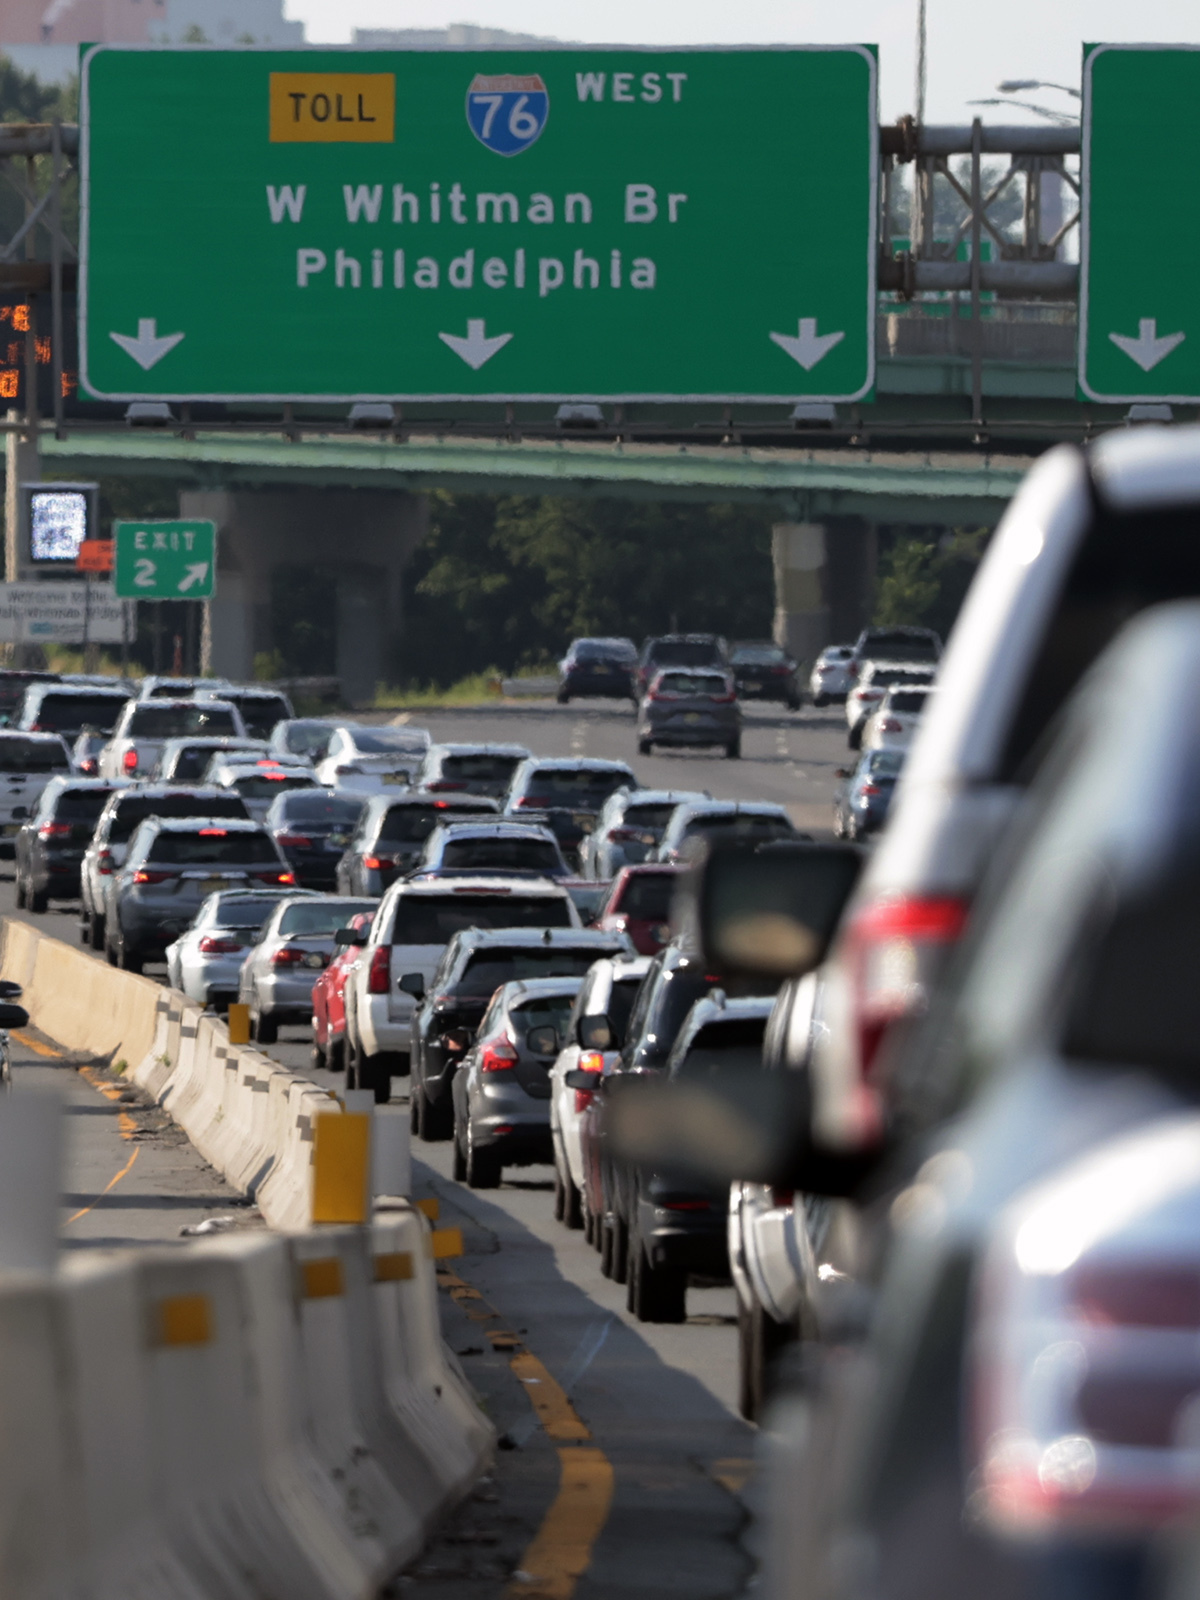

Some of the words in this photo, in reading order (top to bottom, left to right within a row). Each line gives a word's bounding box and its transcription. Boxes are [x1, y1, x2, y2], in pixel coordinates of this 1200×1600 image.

[576, 72, 688, 103] WEST
[288, 92, 376, 122] TOLL
[473, 95, 538, 139] 76
[266, 184, 307, 224] W
[343, 182, 593, 225] Whitman
[625, 183, 688, 224] Br
[297, 247, 657, 298] Philadelphia
[134, 531, 196, 551] EXIT
[134, 558, 157, 587] 2
